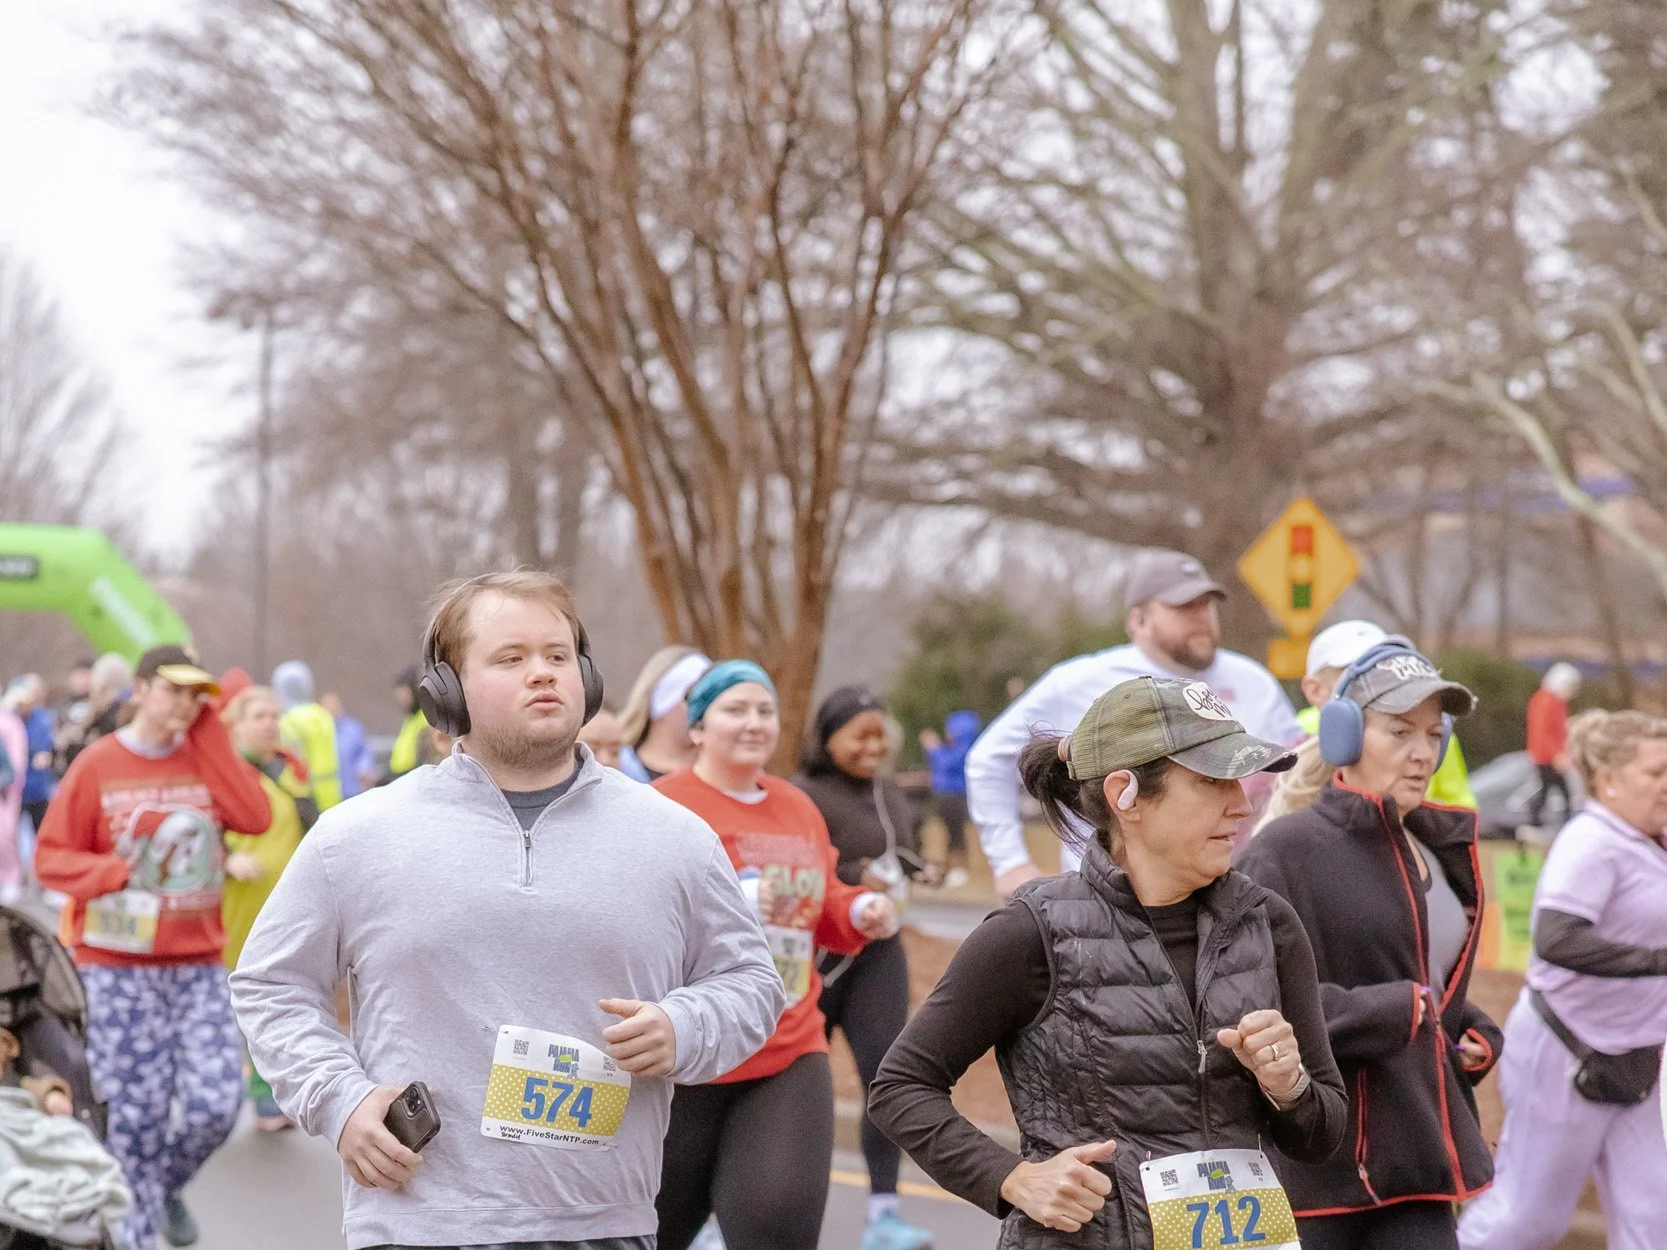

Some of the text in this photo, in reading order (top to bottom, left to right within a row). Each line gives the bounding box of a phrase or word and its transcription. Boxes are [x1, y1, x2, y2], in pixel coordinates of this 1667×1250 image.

[553, 1059, 571, 1073] RUN
[521, 1077, 594, 1128] 574
[500, 1125, 599, 1145] www.FiveStarNTP.com
[1207, 1176, 1226, 1190] RUN
[1186, 1196, 1266, 1249] 712
